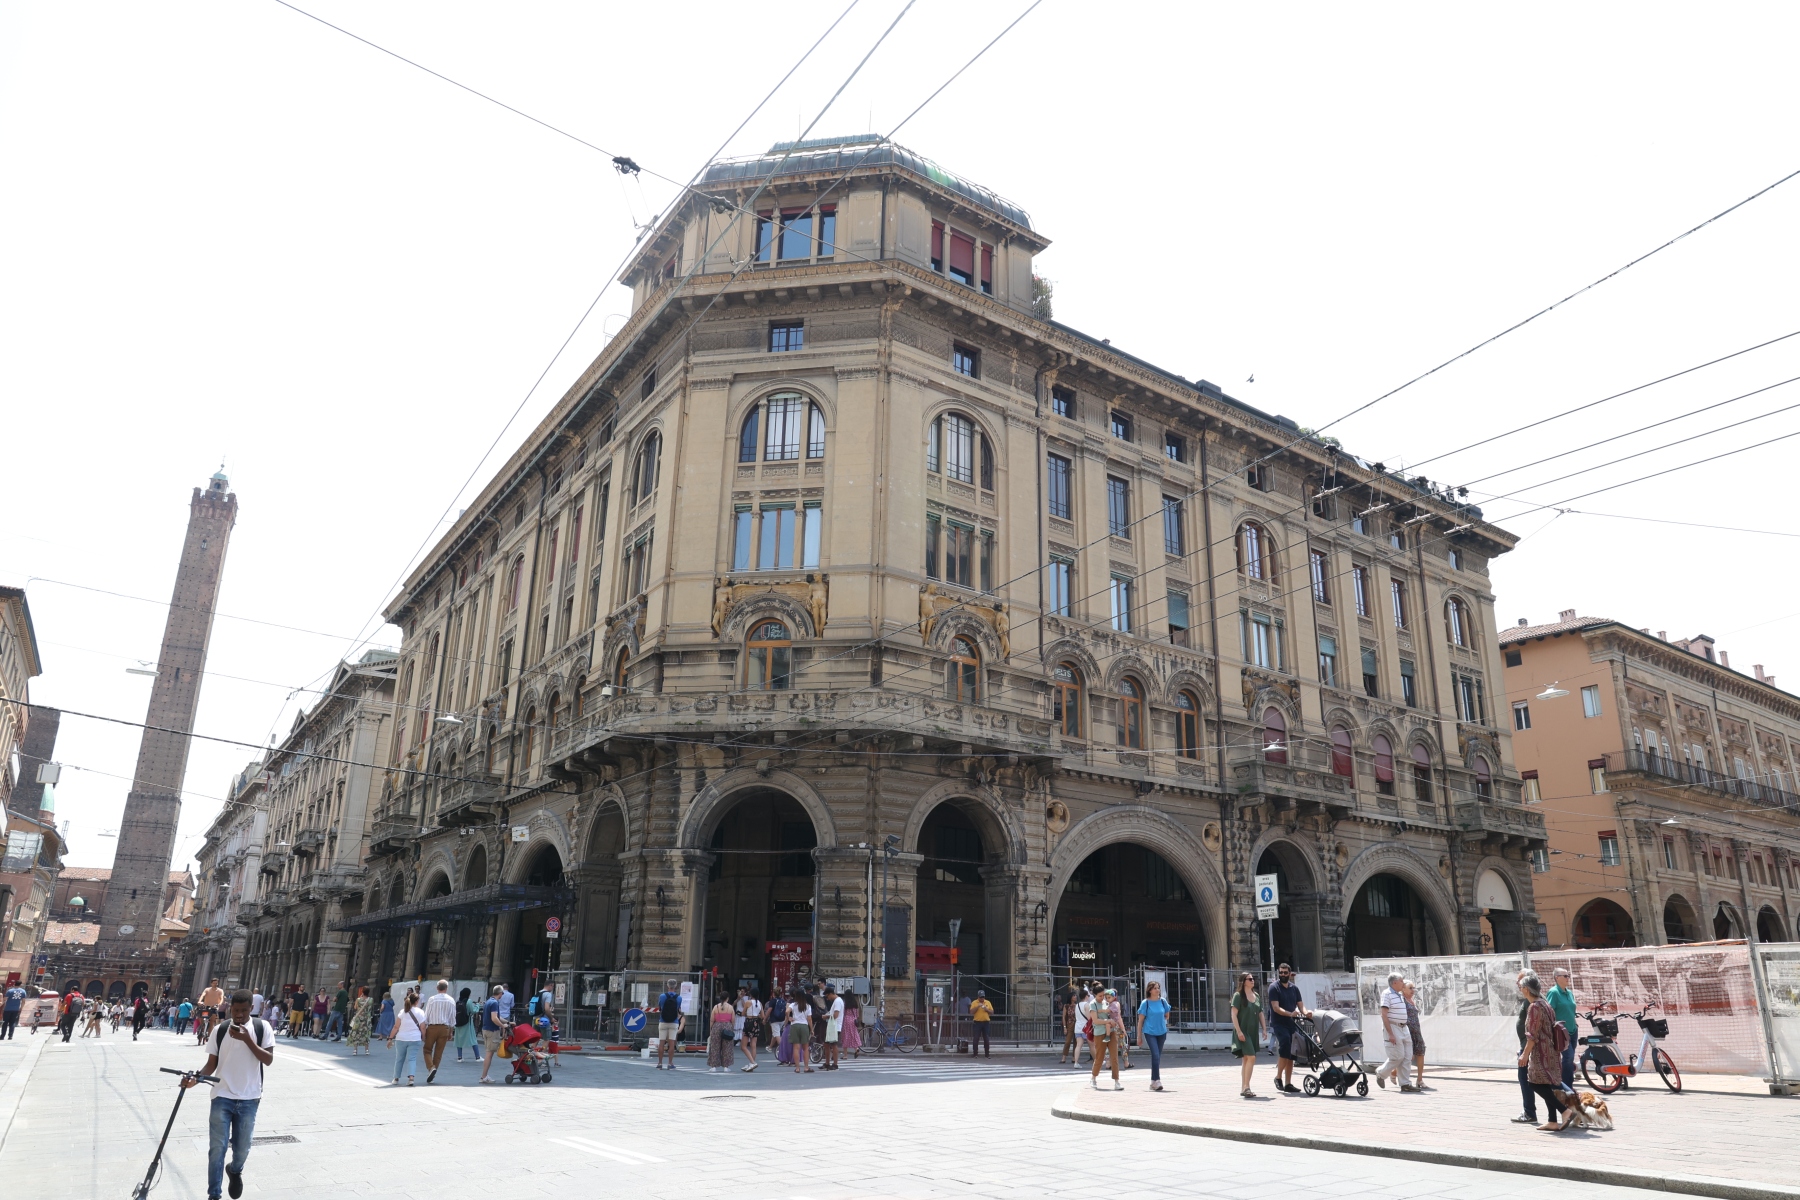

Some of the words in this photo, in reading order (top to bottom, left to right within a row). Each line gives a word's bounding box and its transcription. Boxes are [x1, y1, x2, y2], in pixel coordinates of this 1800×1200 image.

[1446, 491, 1455, 502] 15
[1076, 916, 1105, 926] TEATRO
[1146, 920, 1199, 931] MODERNISSIMO
